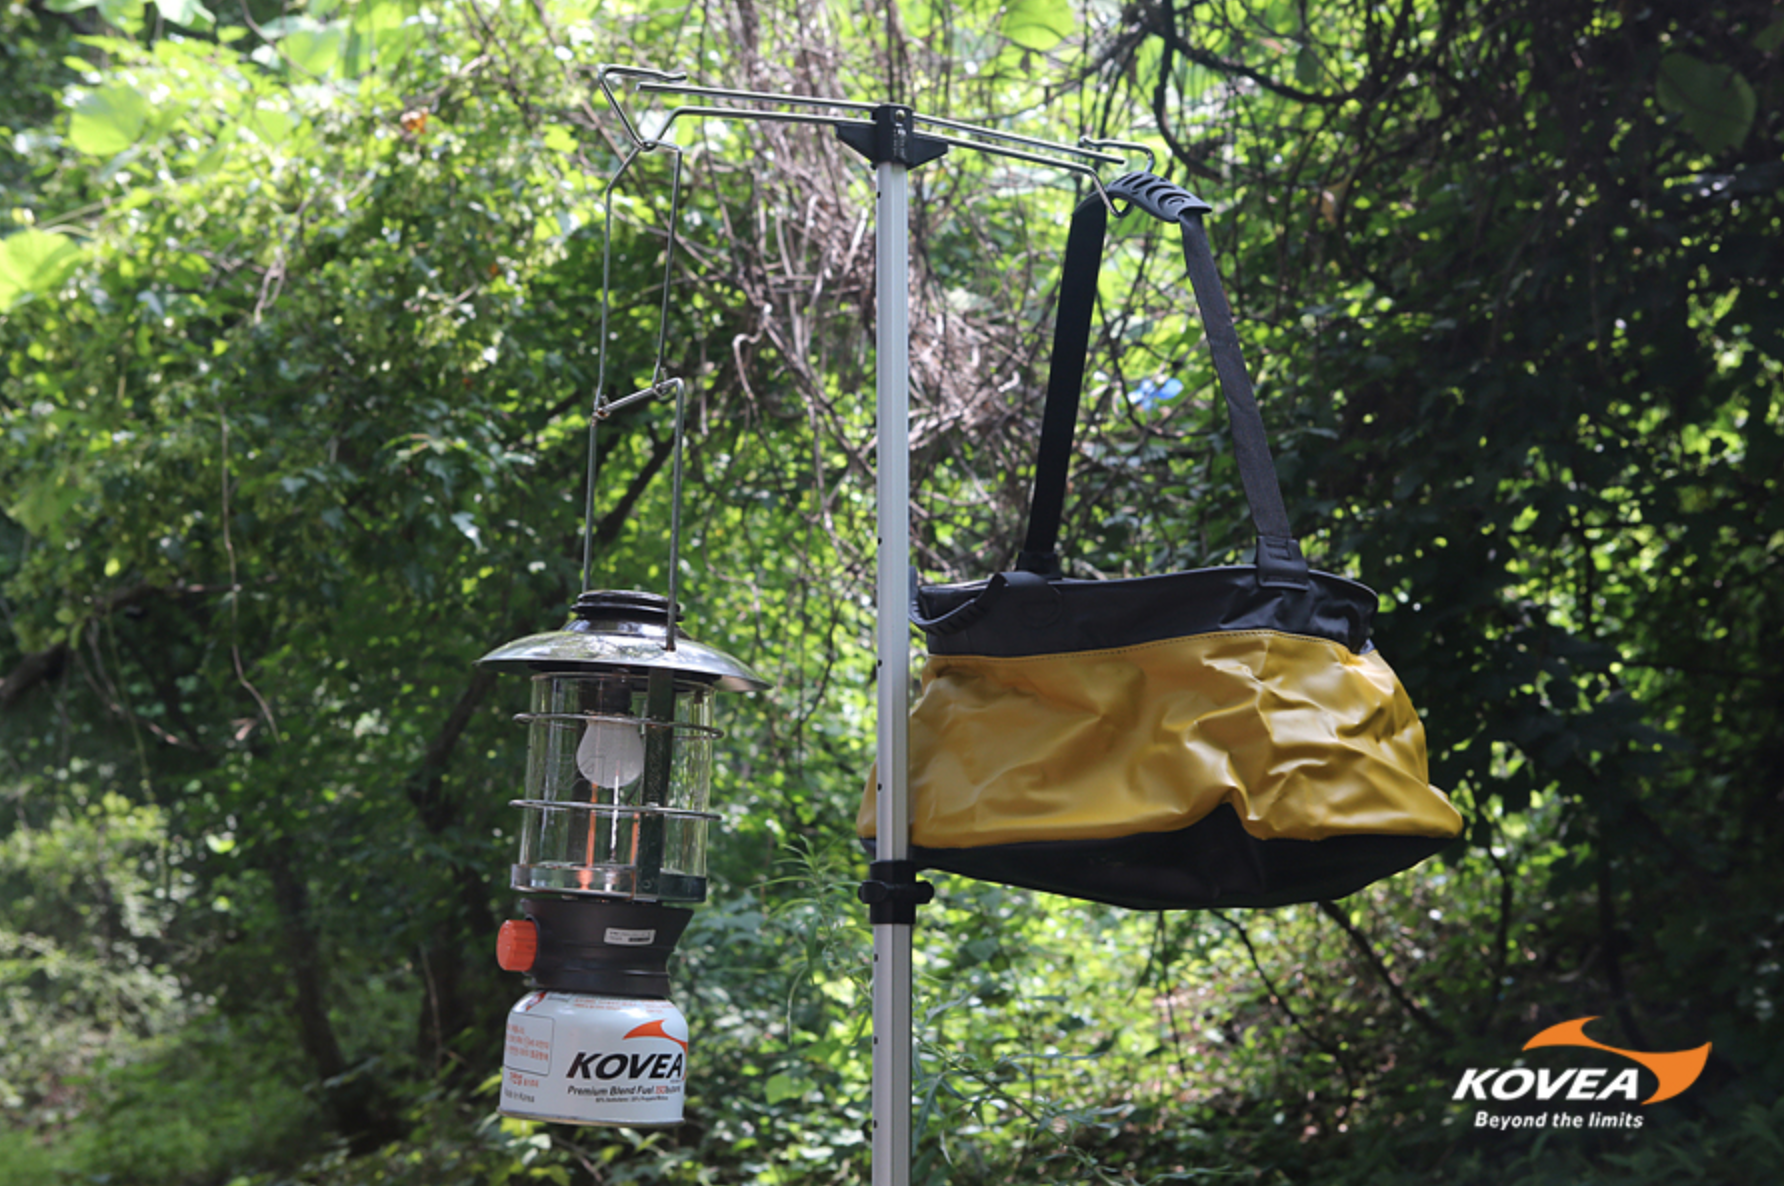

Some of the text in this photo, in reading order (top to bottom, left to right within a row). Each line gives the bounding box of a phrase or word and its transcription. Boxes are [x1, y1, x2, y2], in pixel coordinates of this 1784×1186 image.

[566, 1051, 684, 1081] KOVEA
[567, 1085, 608, 1097] Premium
[609, 1085, 636, 1096] Blend
[636, 1085, 655, 1096] Fuel
